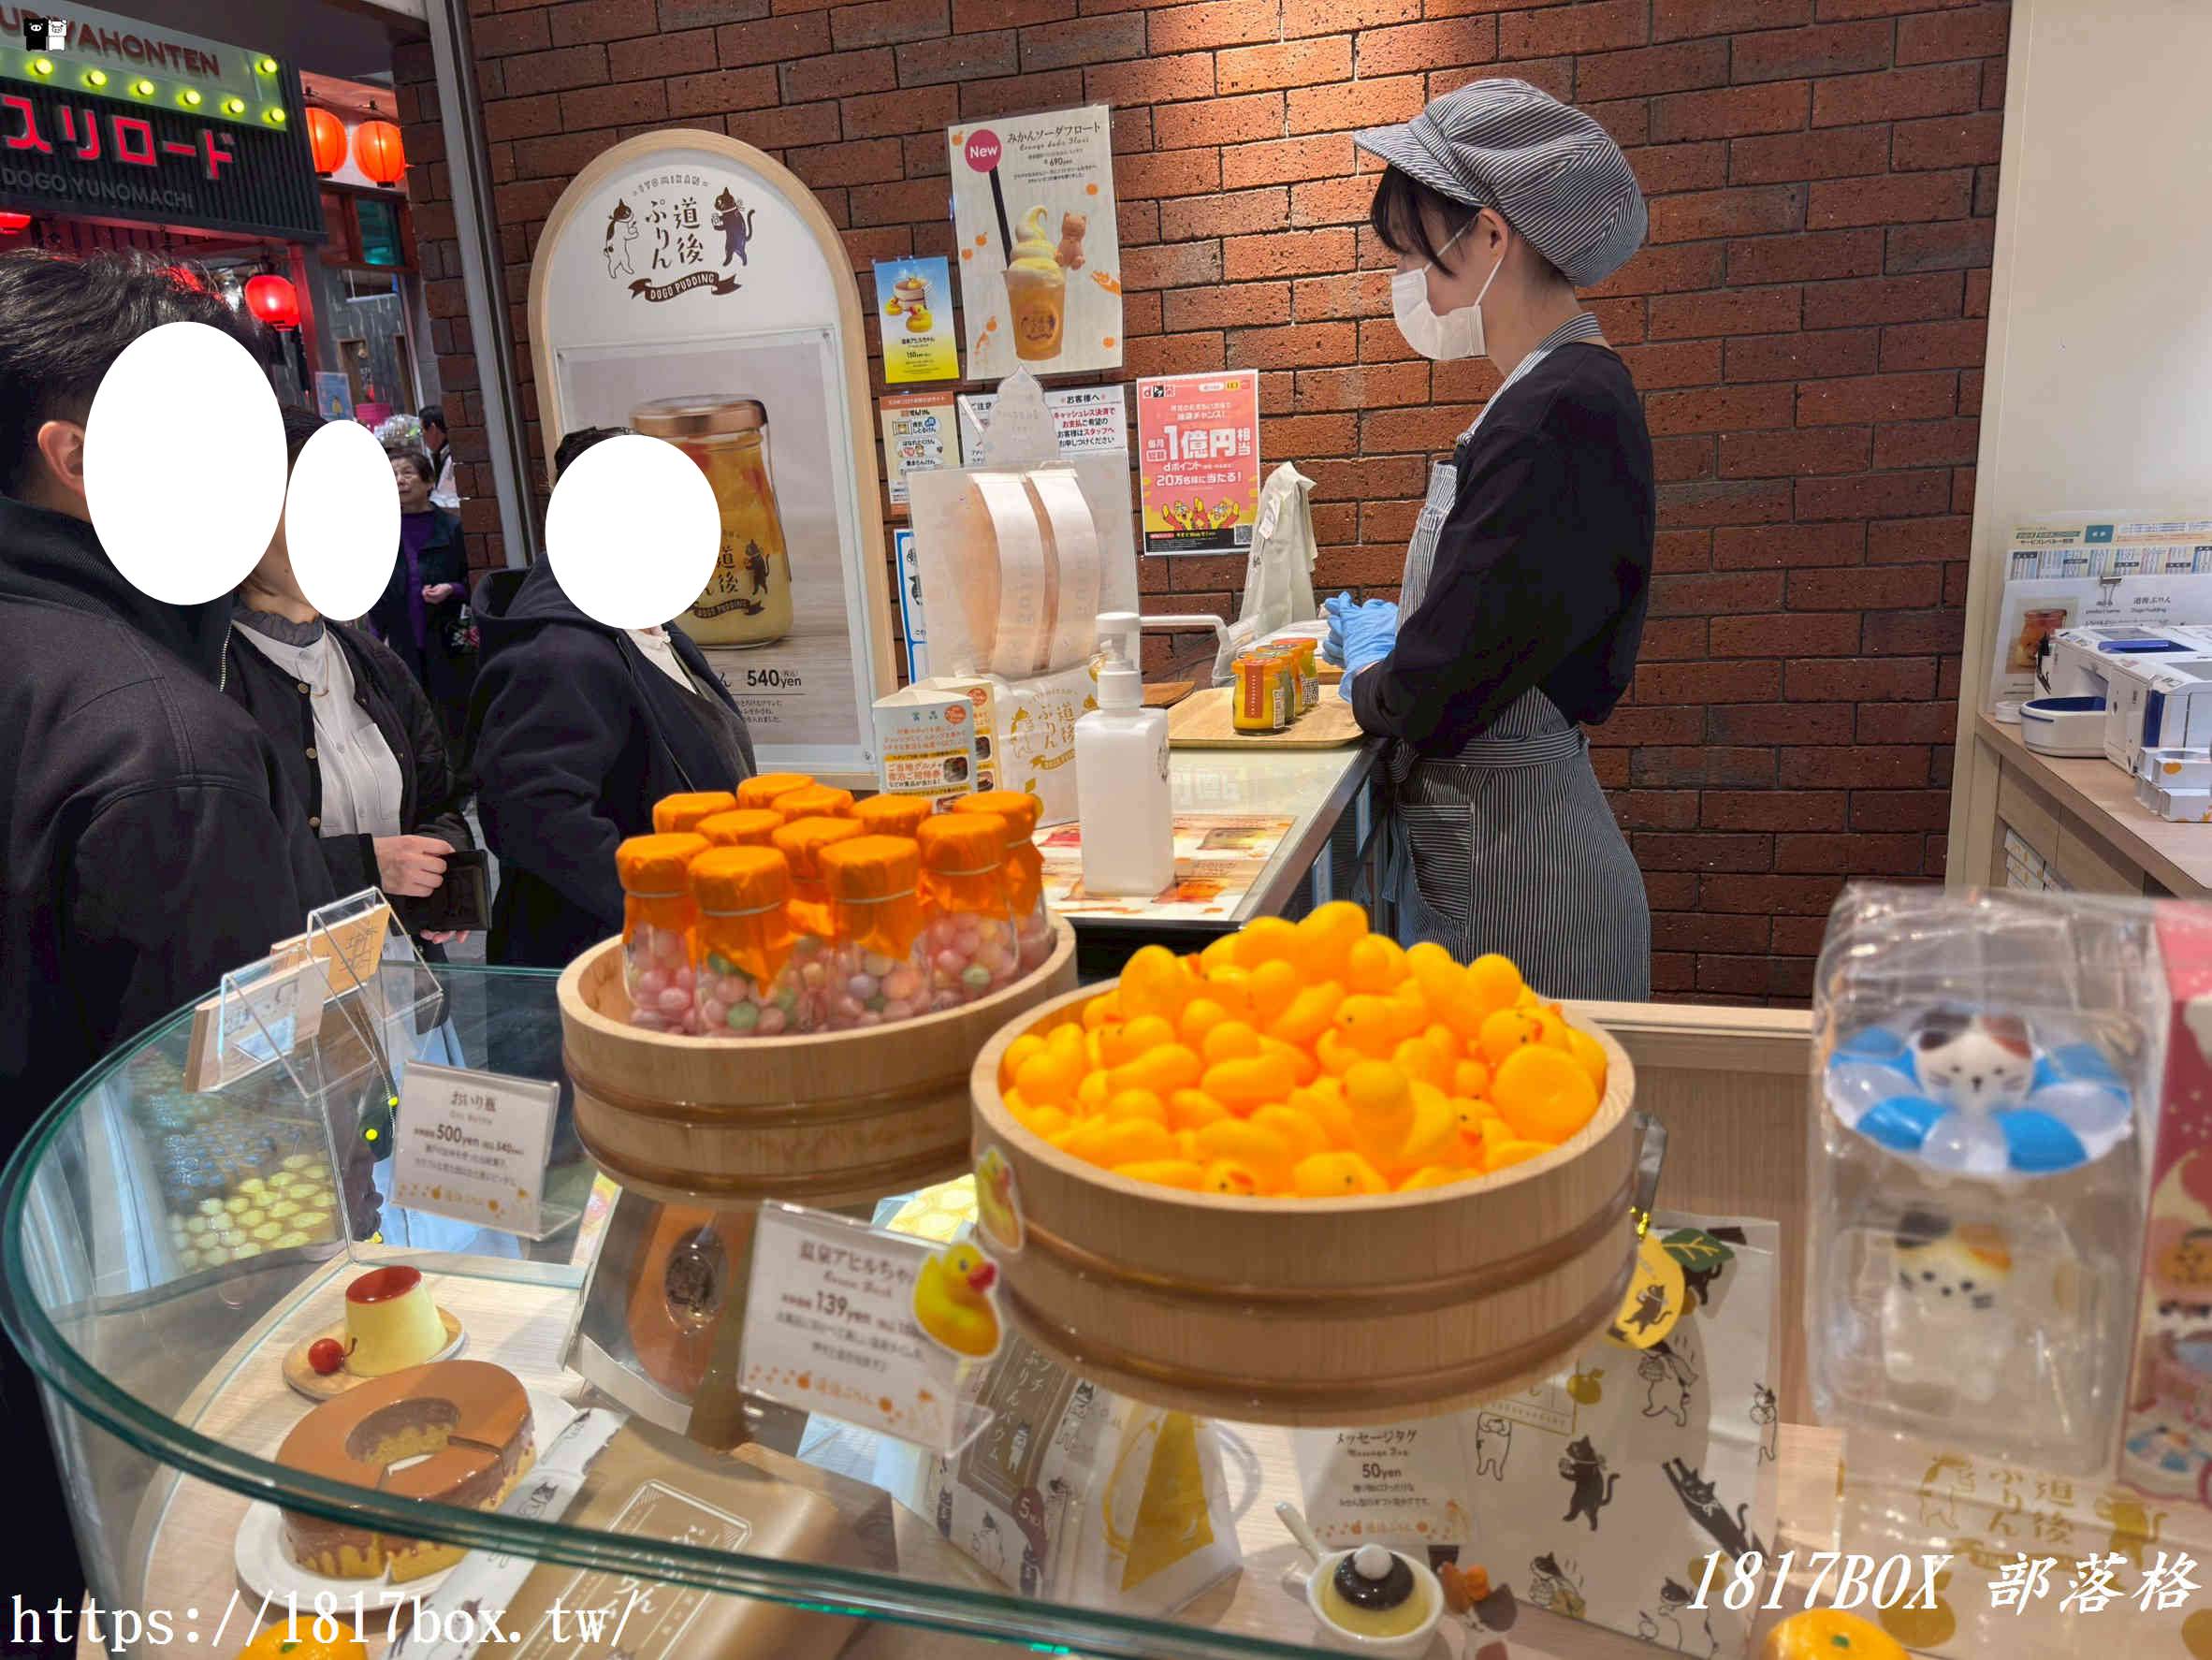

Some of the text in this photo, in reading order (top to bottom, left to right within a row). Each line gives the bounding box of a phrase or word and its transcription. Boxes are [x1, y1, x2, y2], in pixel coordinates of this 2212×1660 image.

[0, 4, 221, 77] UAHONTEN
[969, 144, 997, 159] New
[2, 167, 193, 210] DOGO YUNOMACHI
[646, 198, 673, 269] ぷりん
[674, 197, 704, 265] 道後
[650, 272, 715, 300] DOGO PUDDING
[1067, 394, 1099, 404] お客様へ
[1054, 407, 1116, 419] キャッシュレス決済で
[1163, 425, 1236, 461] 1億円
[748, 669, 802, 689] 540yen
[1336, 1429, 1418, 1446] メッセージタグ
[1361, 1462, 1402, 1479] 50yen
